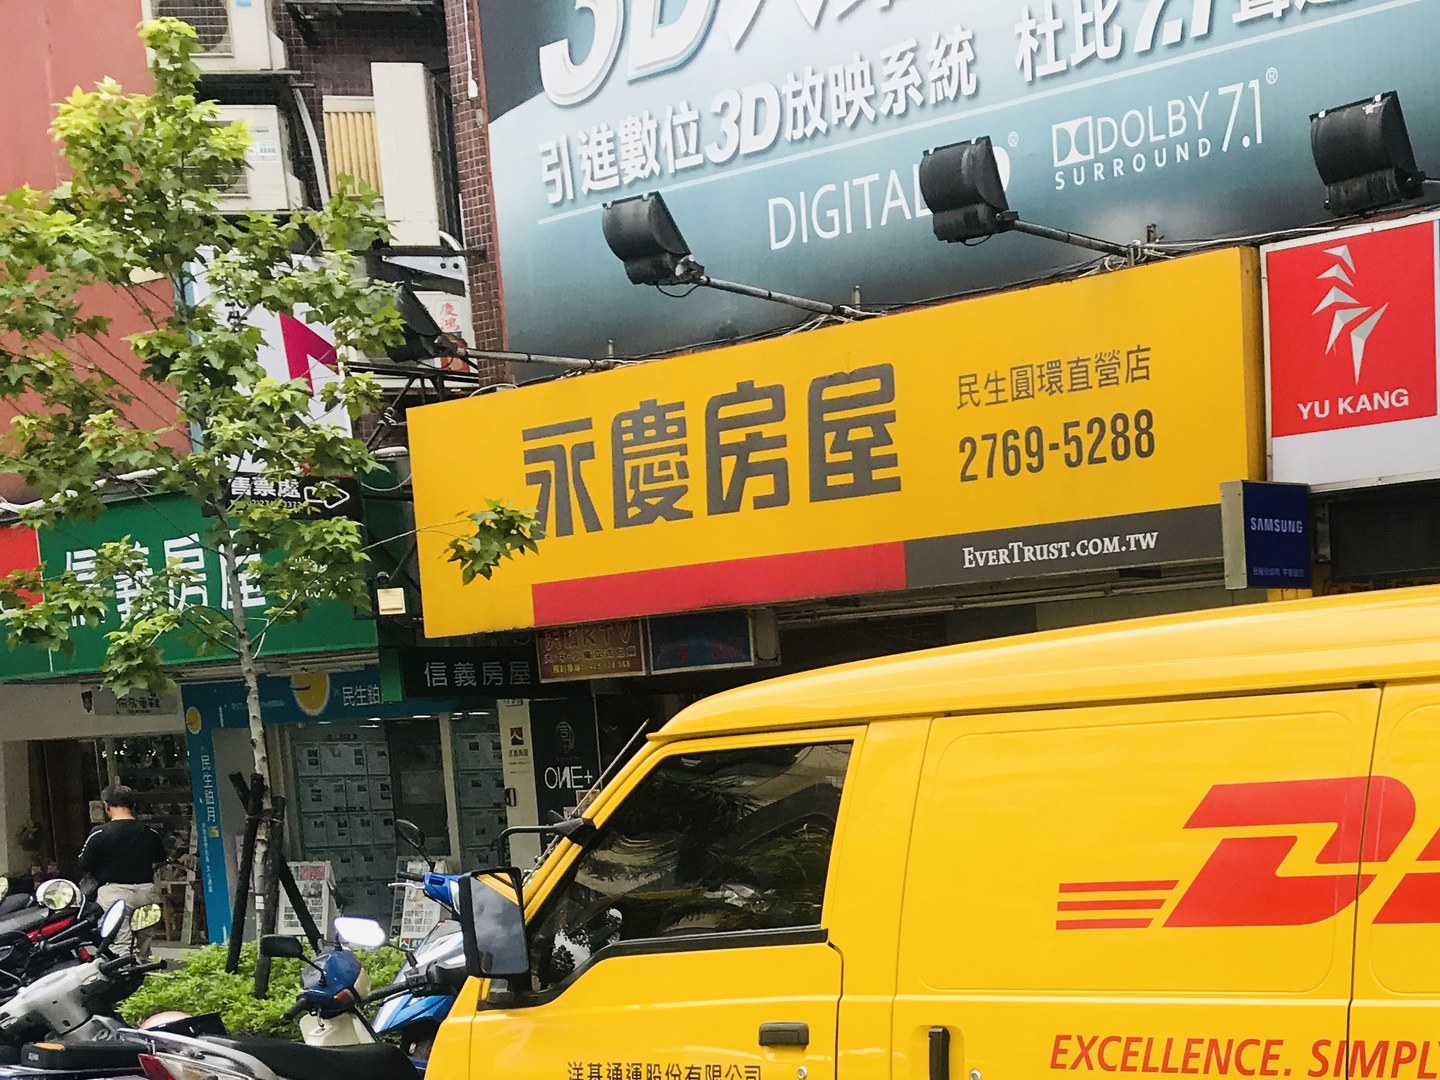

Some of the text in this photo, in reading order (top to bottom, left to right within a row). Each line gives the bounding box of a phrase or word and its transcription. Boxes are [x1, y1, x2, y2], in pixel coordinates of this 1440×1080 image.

[538, 25, 978, 204] 引進數位3D放映系統
[1098, 91, 1210, 155] DOLBY
[1054, 138, 1212, 190] SURROUND
[956, 344, 1152, 410] 民生圓環直營店
[1297, 388, 1410, 421] YU KANG
[521, 363, 902, 540] 永慶房屋
[958, 408, 1156, 483] 2769-5288
[1250, 517, 1303, 534] SAMSUNG
[424, 661, 532, 687] 信義房屋
[1049, 1034, 1292, 1077] EXCELLENCE.
